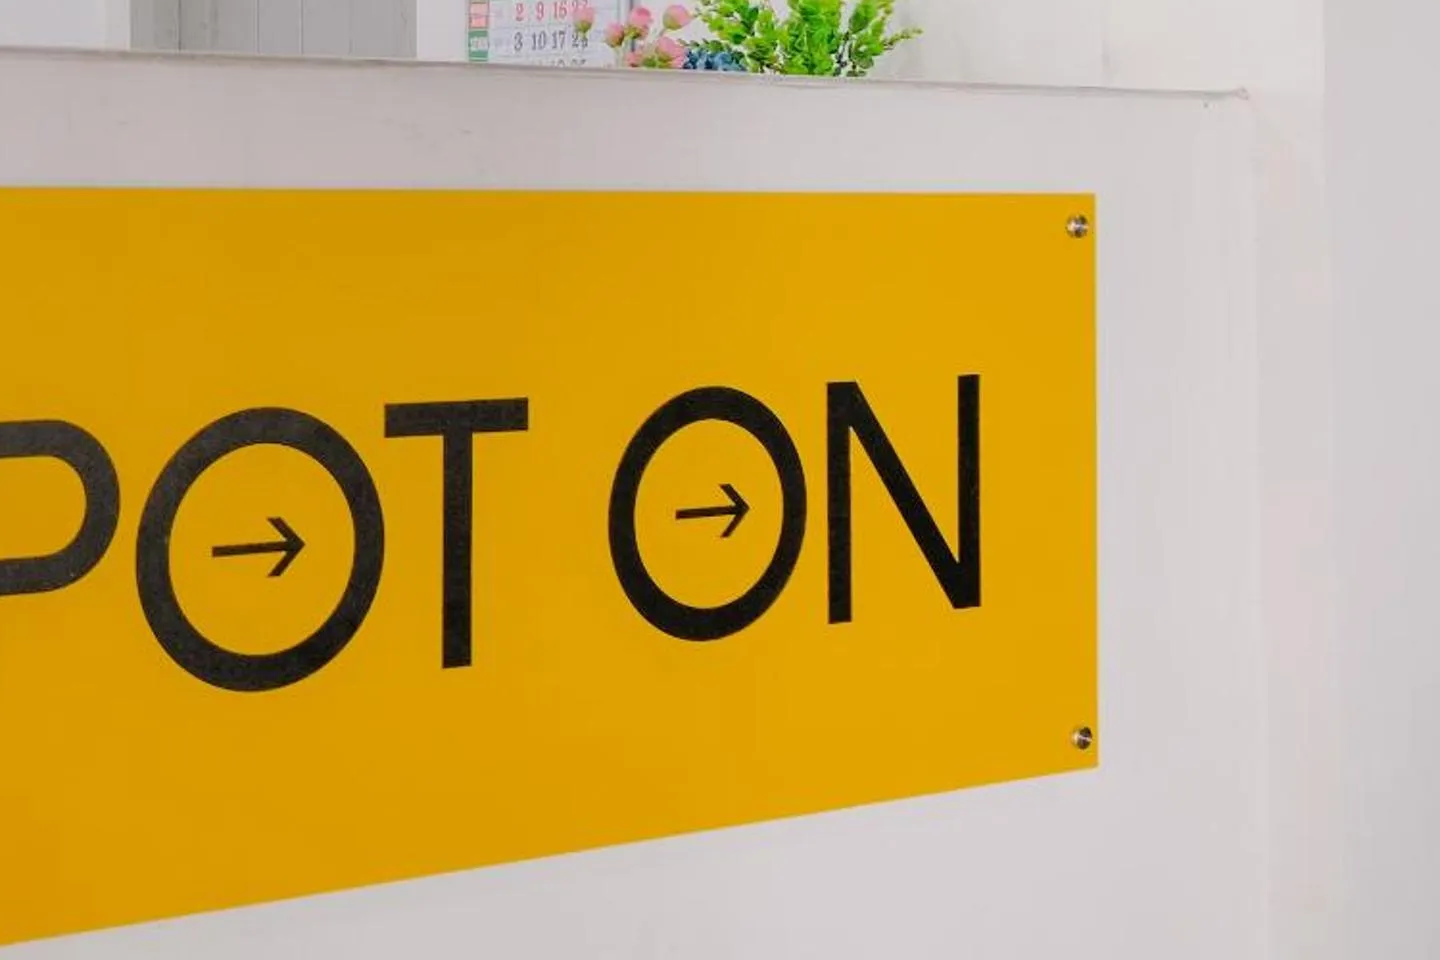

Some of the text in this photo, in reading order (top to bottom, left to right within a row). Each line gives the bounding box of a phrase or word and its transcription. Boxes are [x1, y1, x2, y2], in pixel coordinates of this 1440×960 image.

[515, 1, 525, 22] 2
[535, 0, 545, 21] 9
[553, 0, 568, 19] 16
[514, 30, 524, 52] 3
[531, 30, 547, 51] 10
[551, 29, 566, 50] 17
[608, 374, 981, 642] ON
